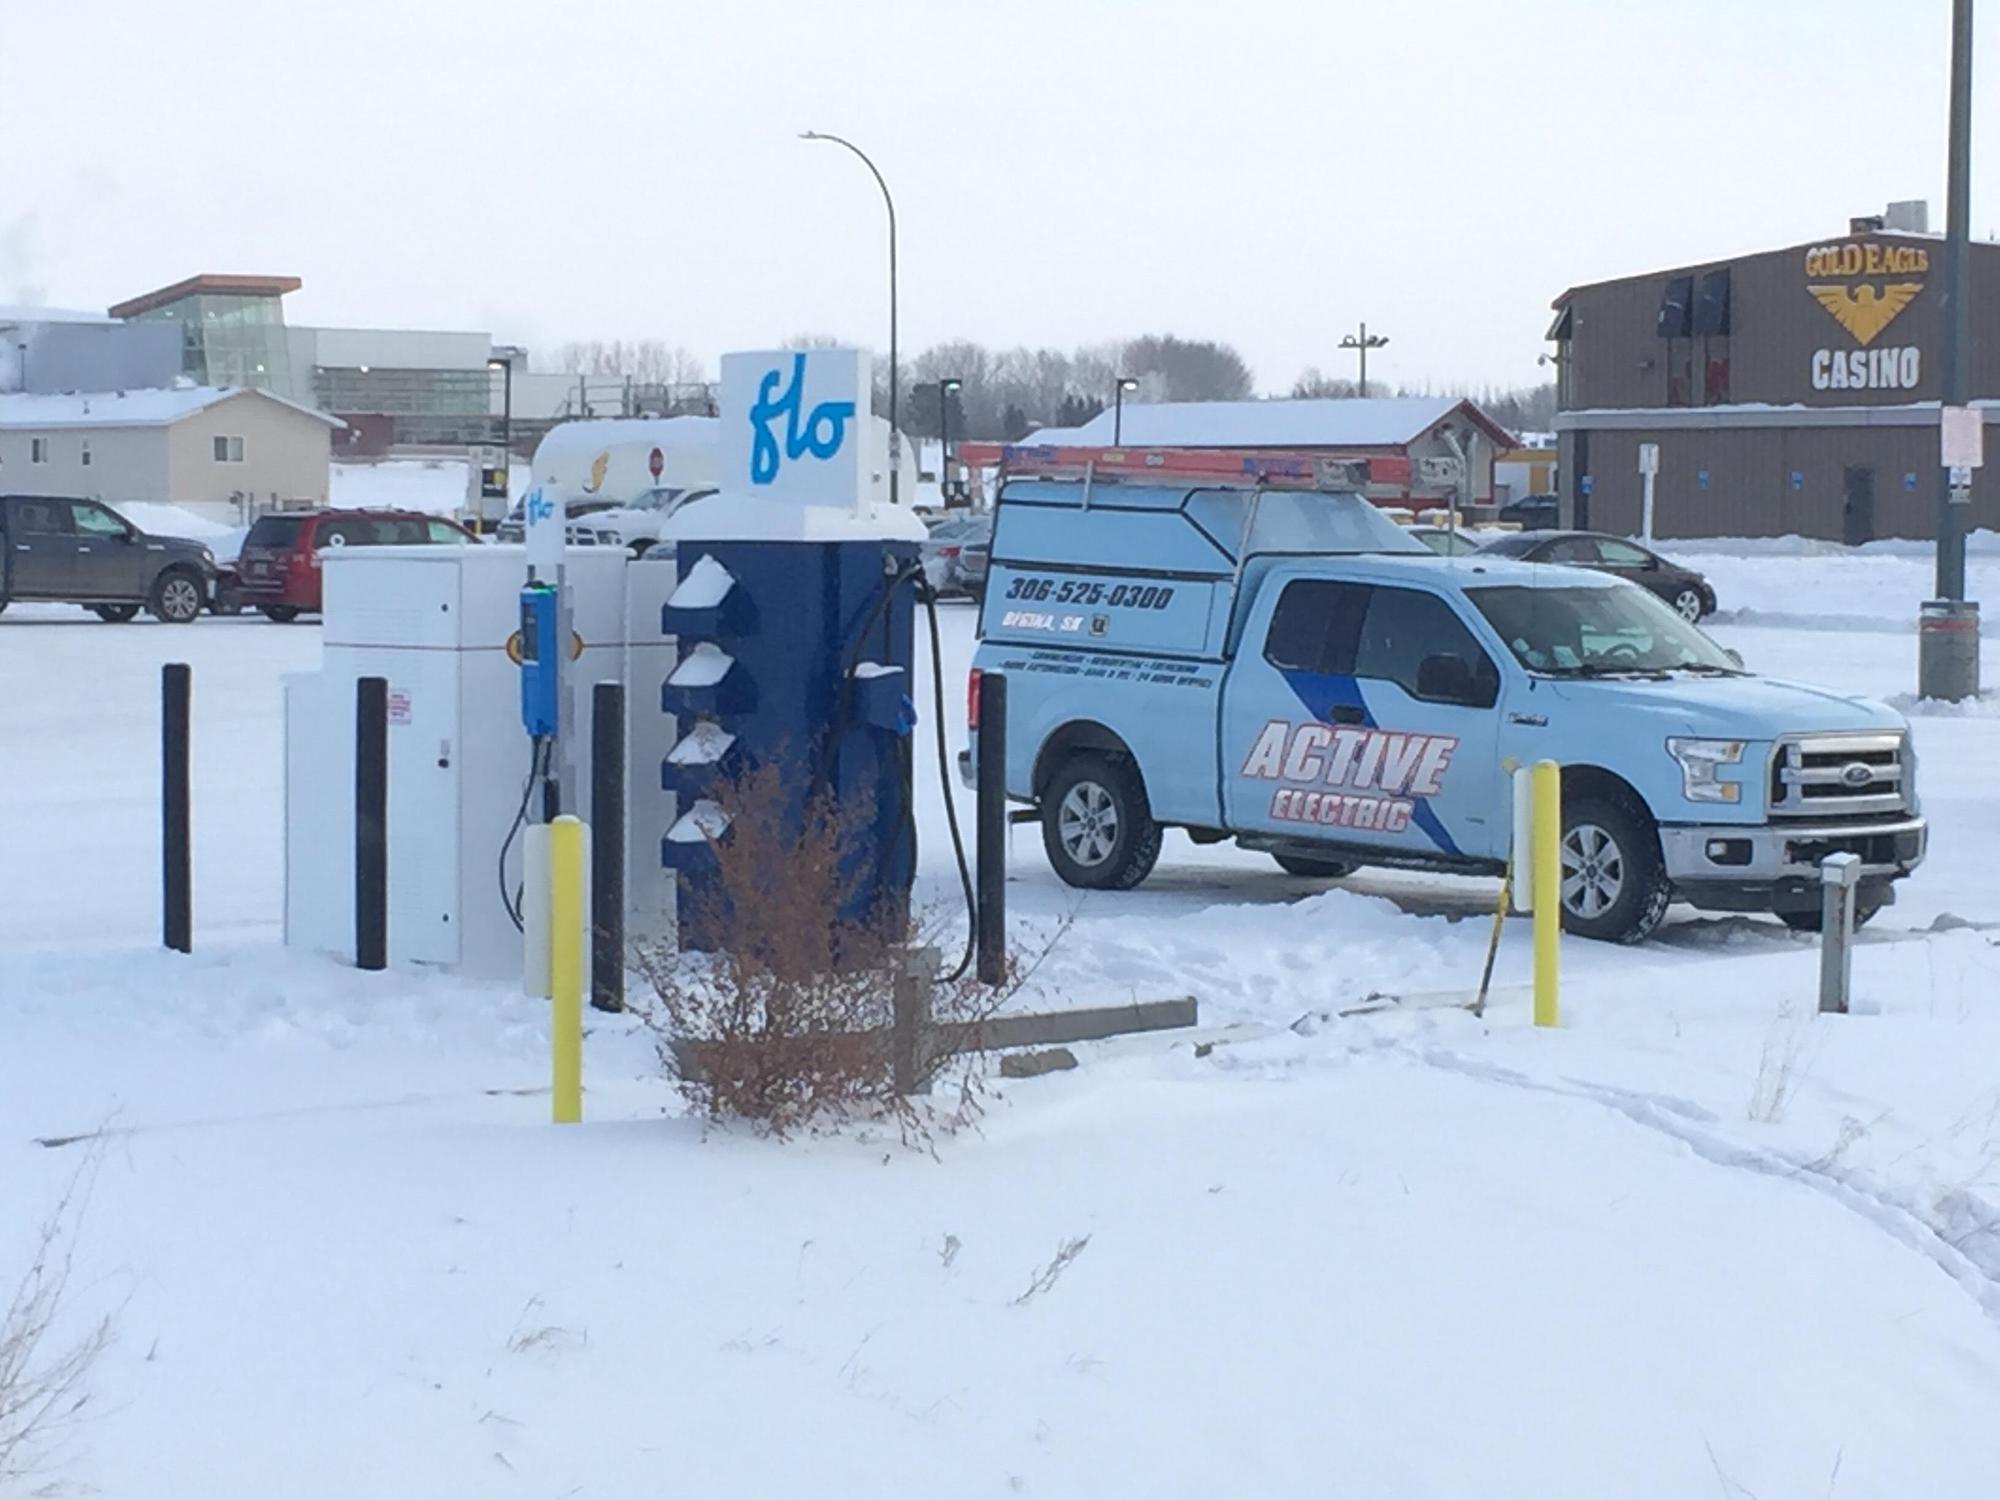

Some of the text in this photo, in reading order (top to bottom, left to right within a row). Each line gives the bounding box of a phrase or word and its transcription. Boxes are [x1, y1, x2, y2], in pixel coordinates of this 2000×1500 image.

[1811, 346, 1921, 390] CASINO
[749, 352, 856, 484] flo
[1005, 577, 1174, 610] 306-525-0300
[1242, 720, 1460, 796] ACTIVE
[1270, 788, 1414, 832] ELECTRIC
